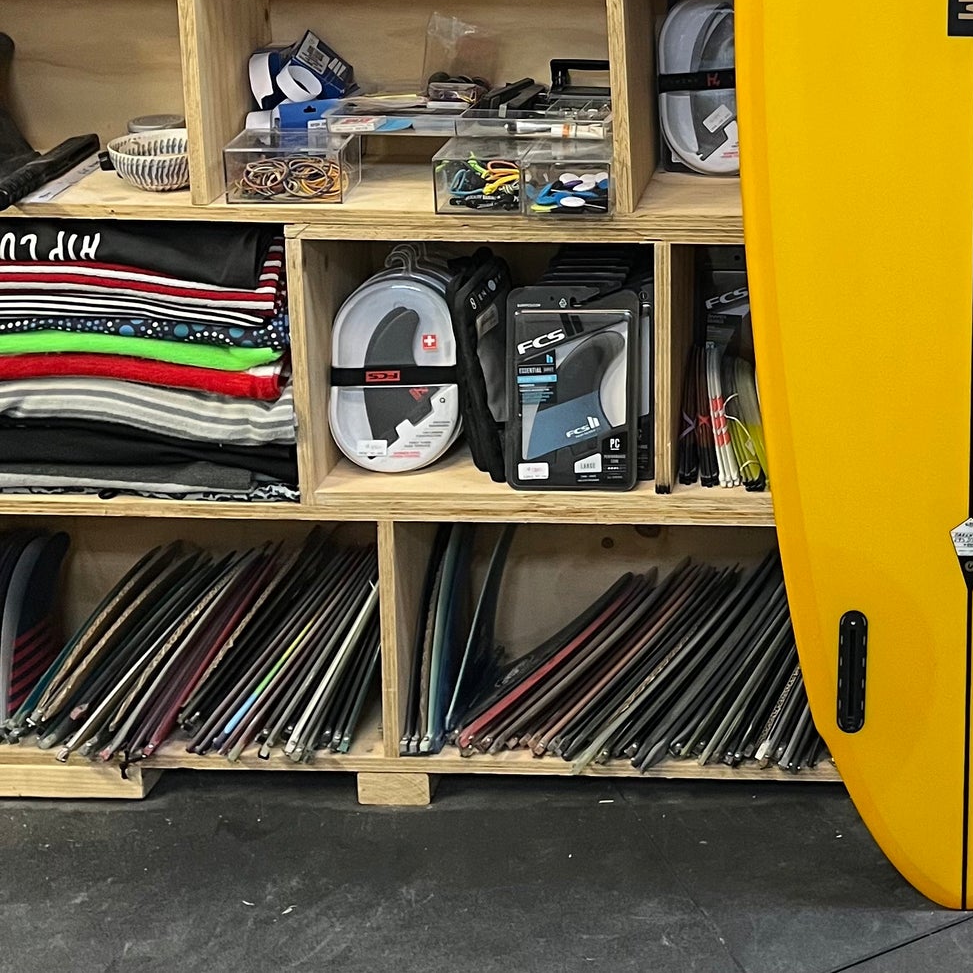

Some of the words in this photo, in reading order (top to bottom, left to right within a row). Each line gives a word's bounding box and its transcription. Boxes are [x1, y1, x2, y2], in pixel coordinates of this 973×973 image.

[705, 286, 748, 309] FCS
[517, 328, 566, 355] FCS
[365, 372, 399, 381] FCS
[610, 438, 620, 448] PC
